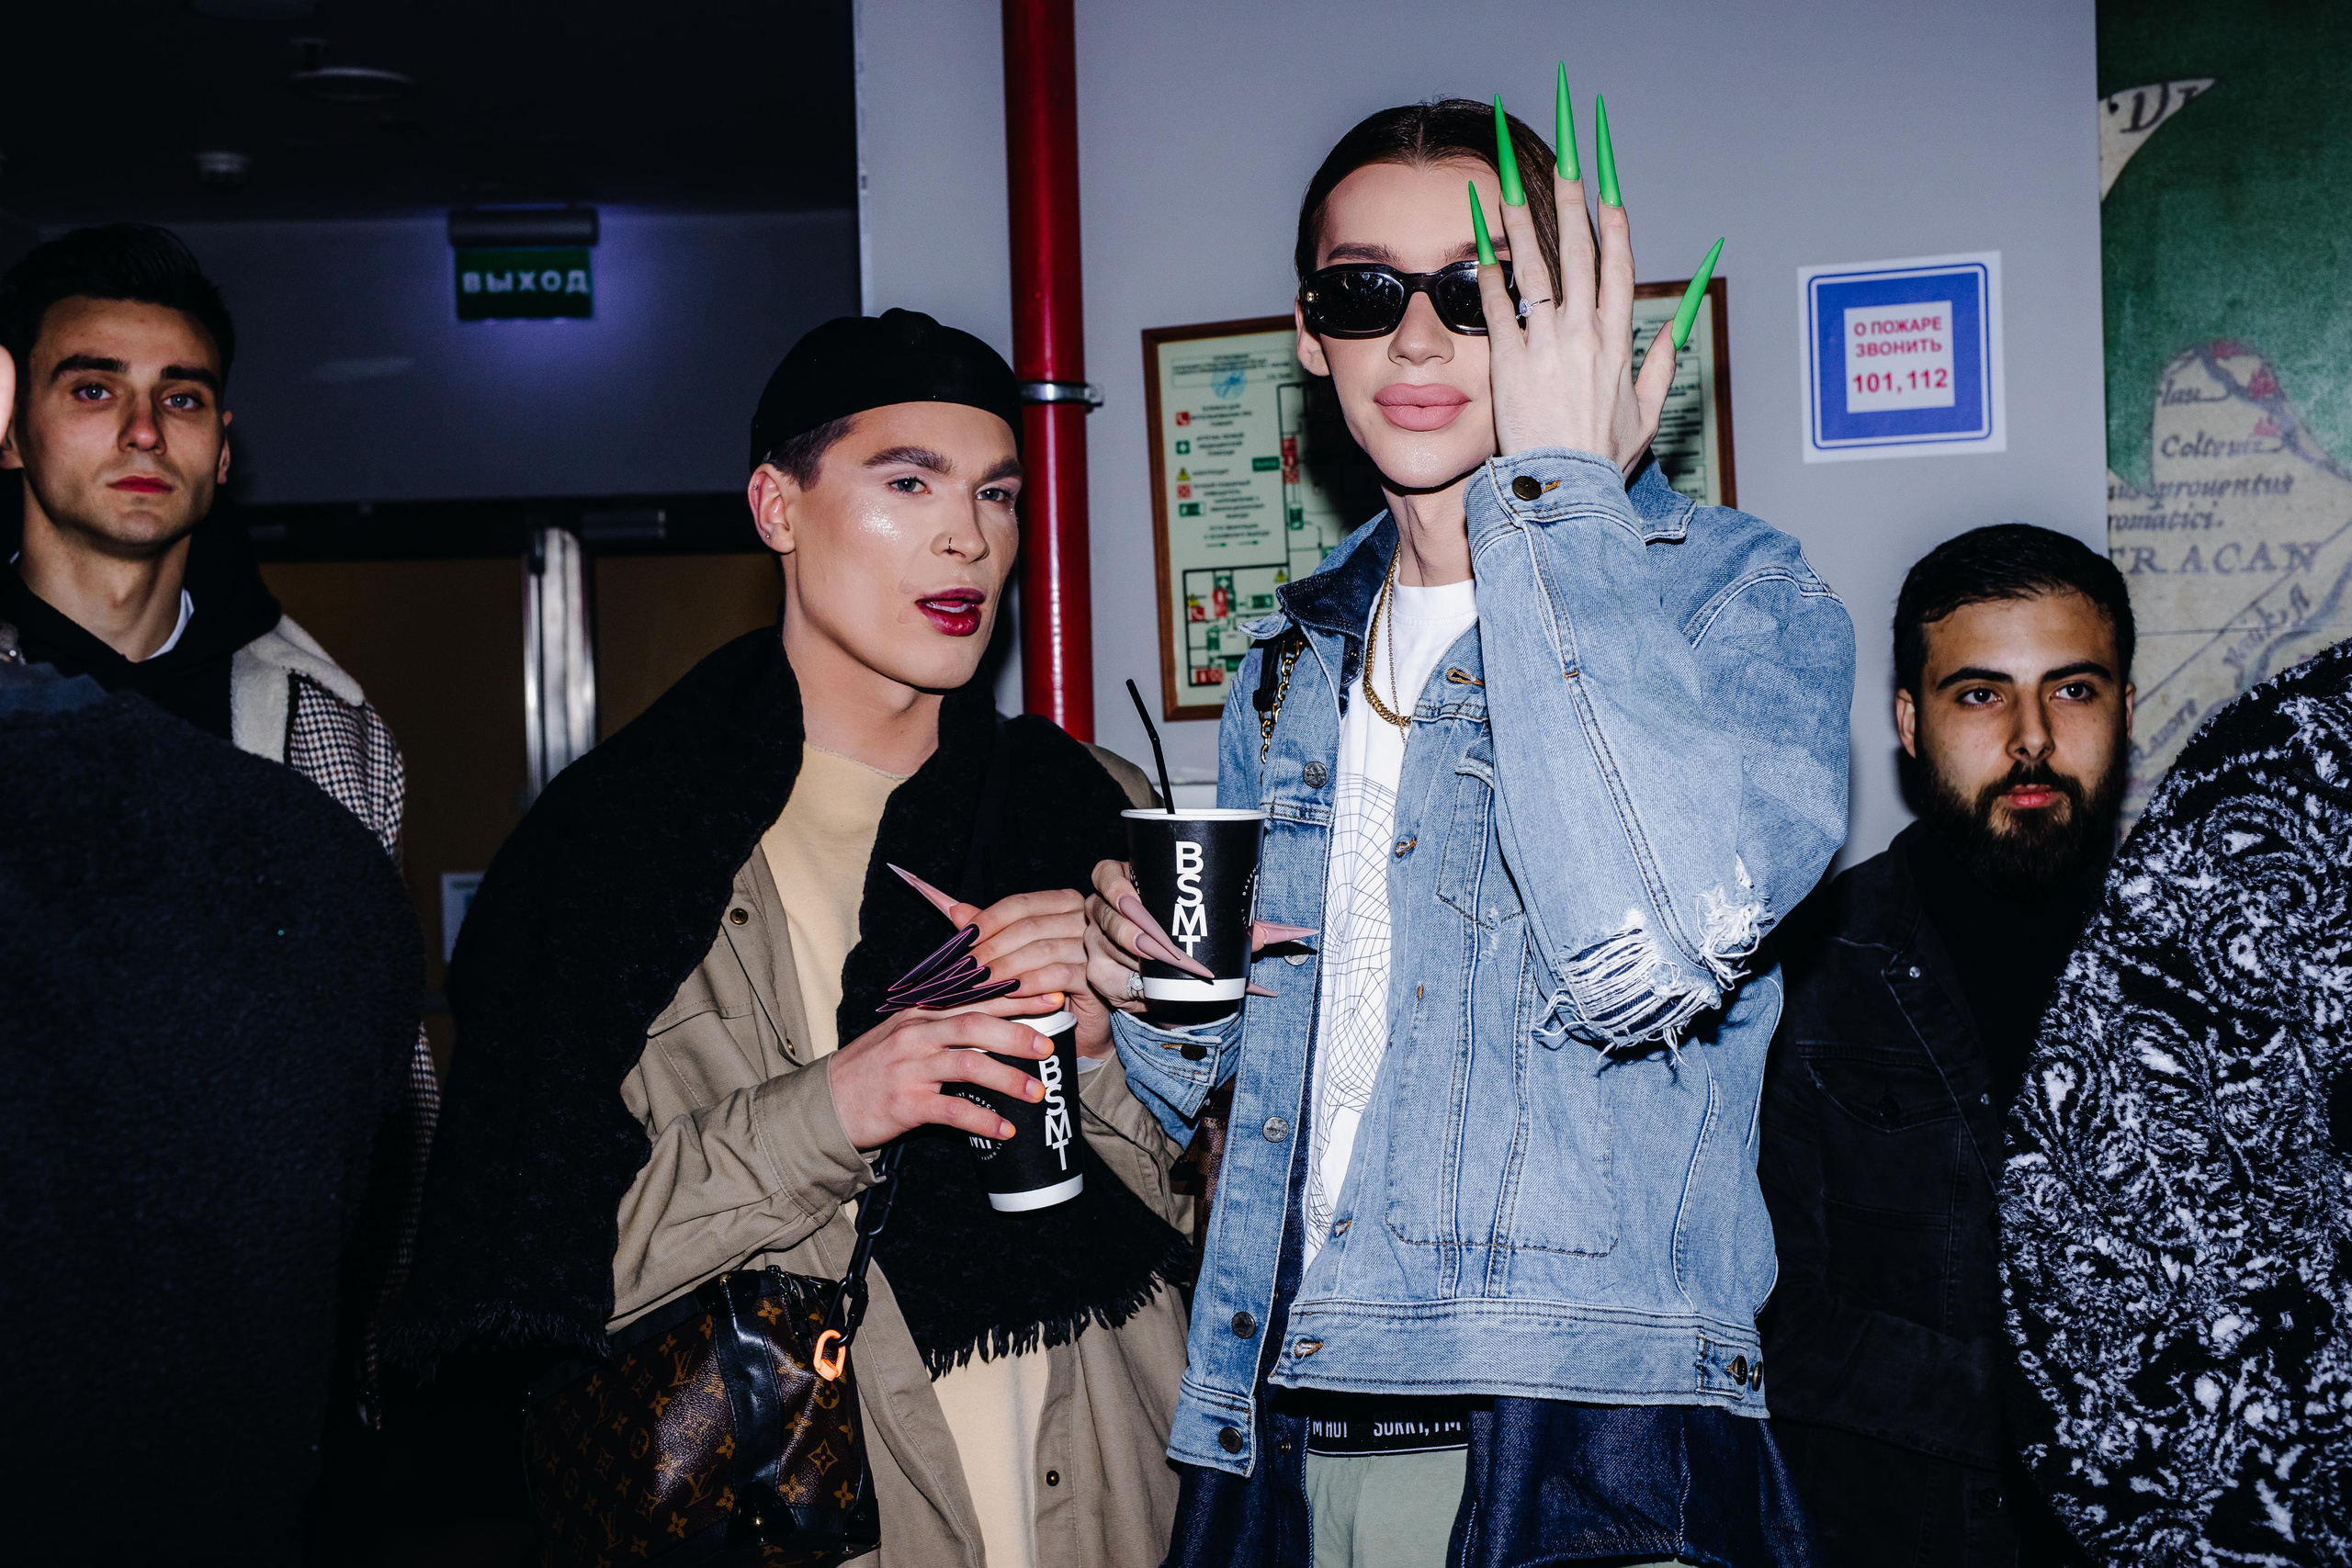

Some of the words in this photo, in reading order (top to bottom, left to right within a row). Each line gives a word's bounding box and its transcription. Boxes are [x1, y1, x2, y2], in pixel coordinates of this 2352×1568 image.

[462, 269, 589, 294] ВЫХОД
[1853, 321, 1867, 337] О
[1871, 316, 1942, 336] ПОЖАРЕ
[1855, 338, 1942, 358] ЗВОНИТЬ
[1172, 840, 1208, 959] BSMT
[1038, 1055, 1073, 1171] BSMT
